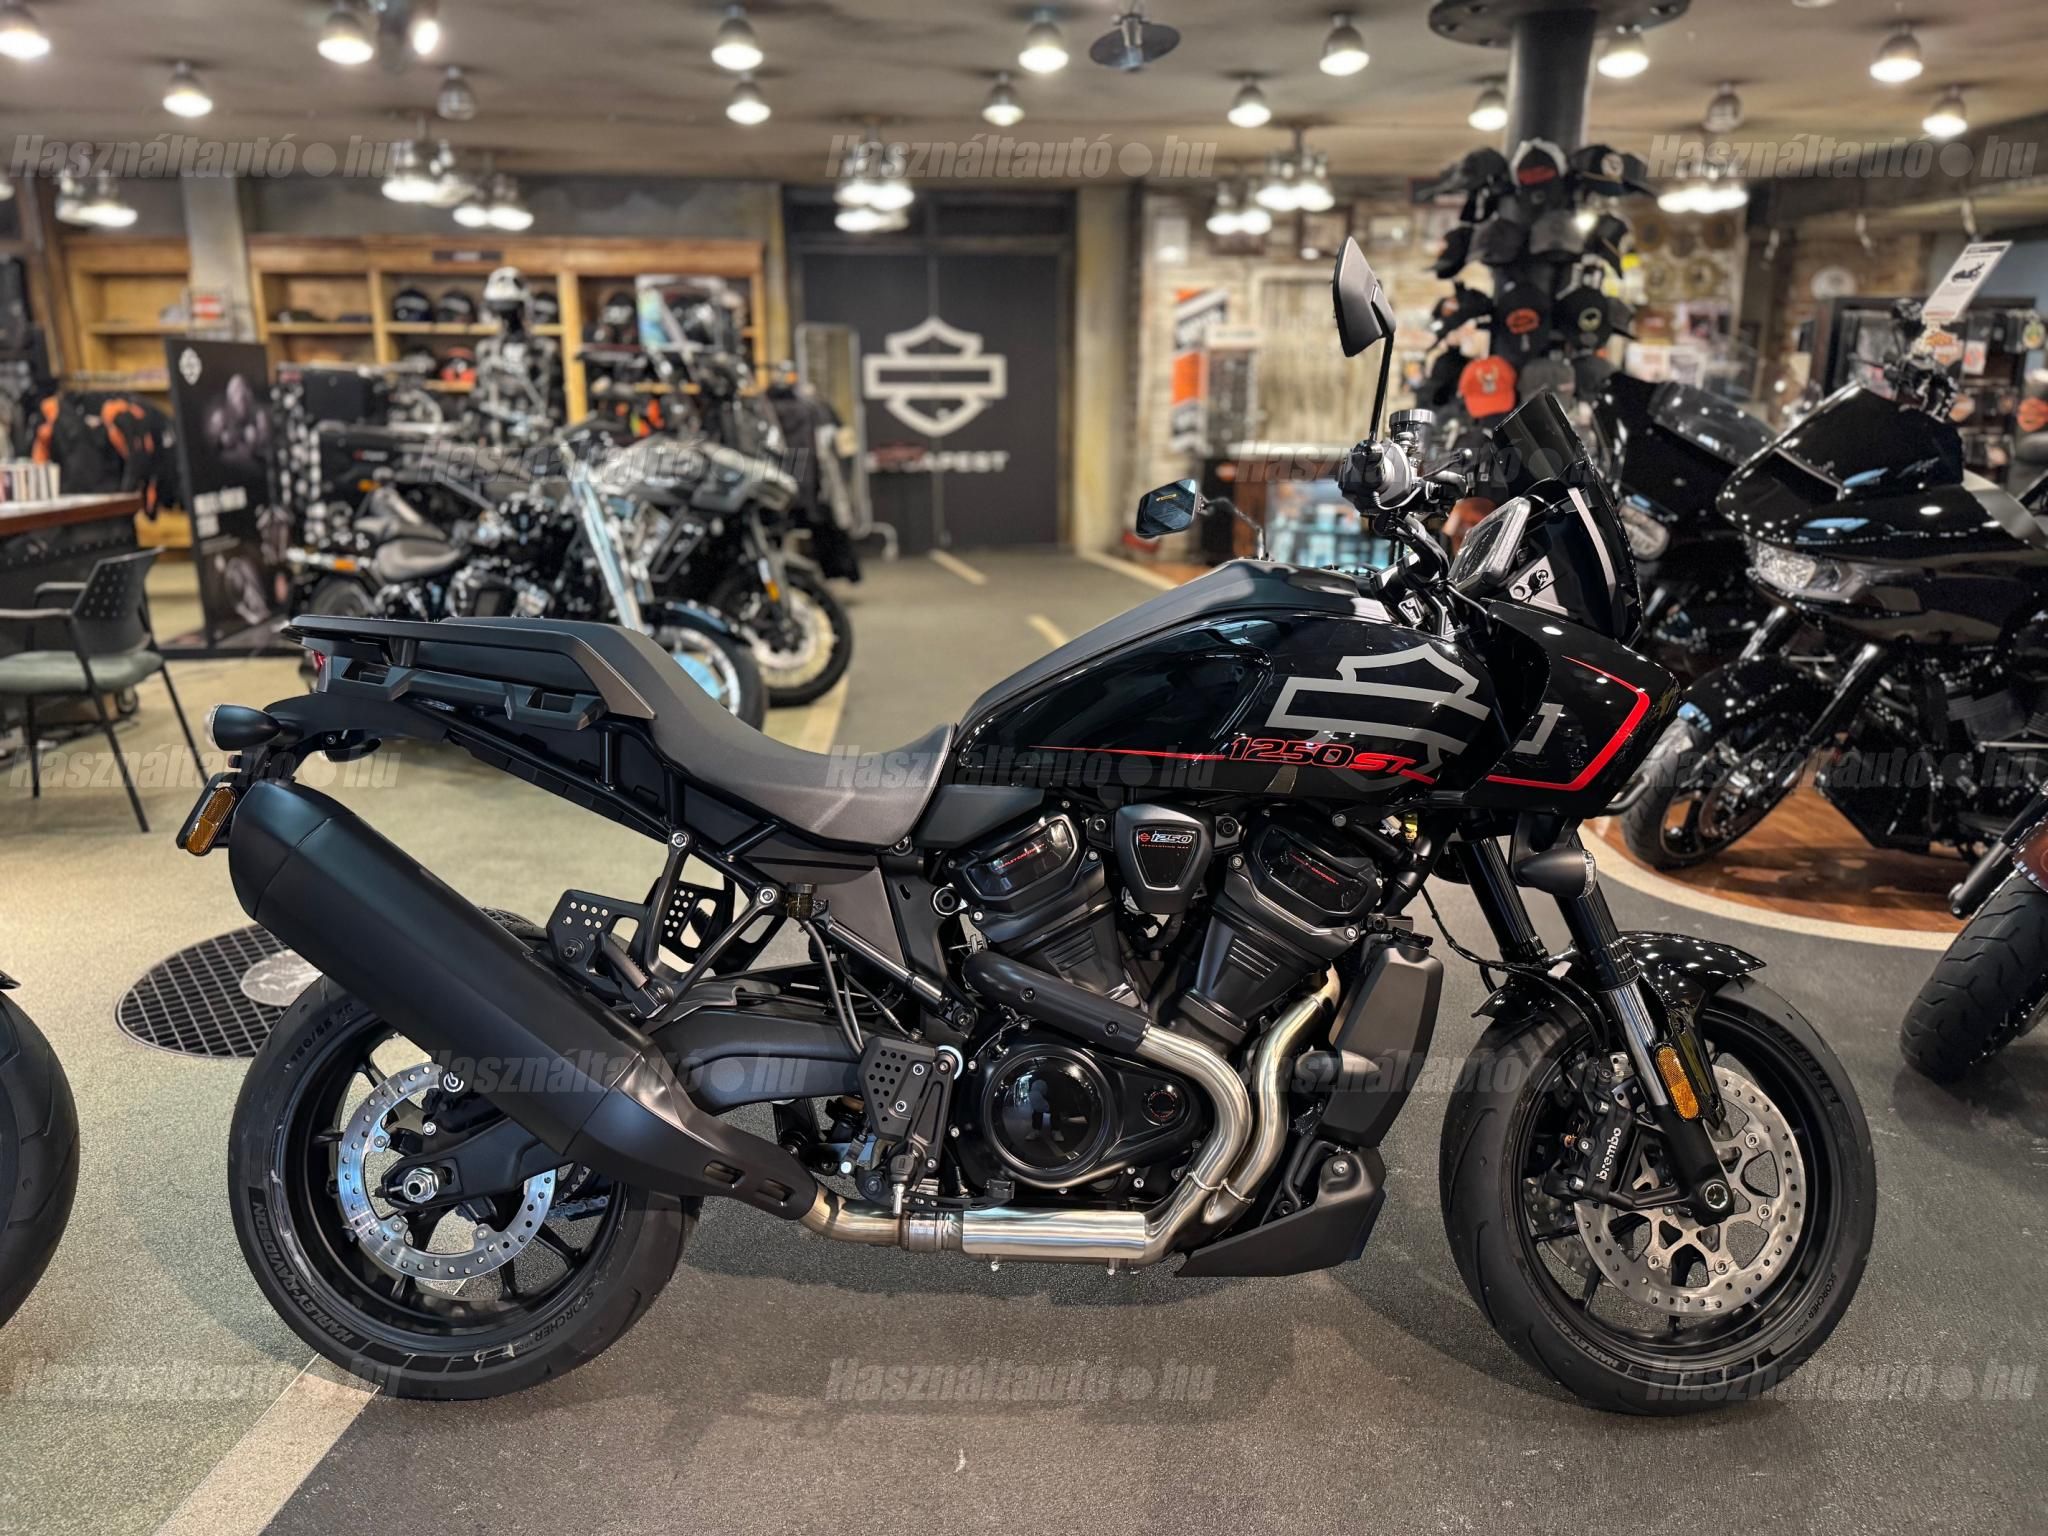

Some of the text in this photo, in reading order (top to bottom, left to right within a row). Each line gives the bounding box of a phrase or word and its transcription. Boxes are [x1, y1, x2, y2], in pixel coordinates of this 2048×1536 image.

[1151, 833, 1193, 844] 1250
[1595, 1127, 1622, 1180] brembo
[534, 1287, 595, 1342] SCORCHER
